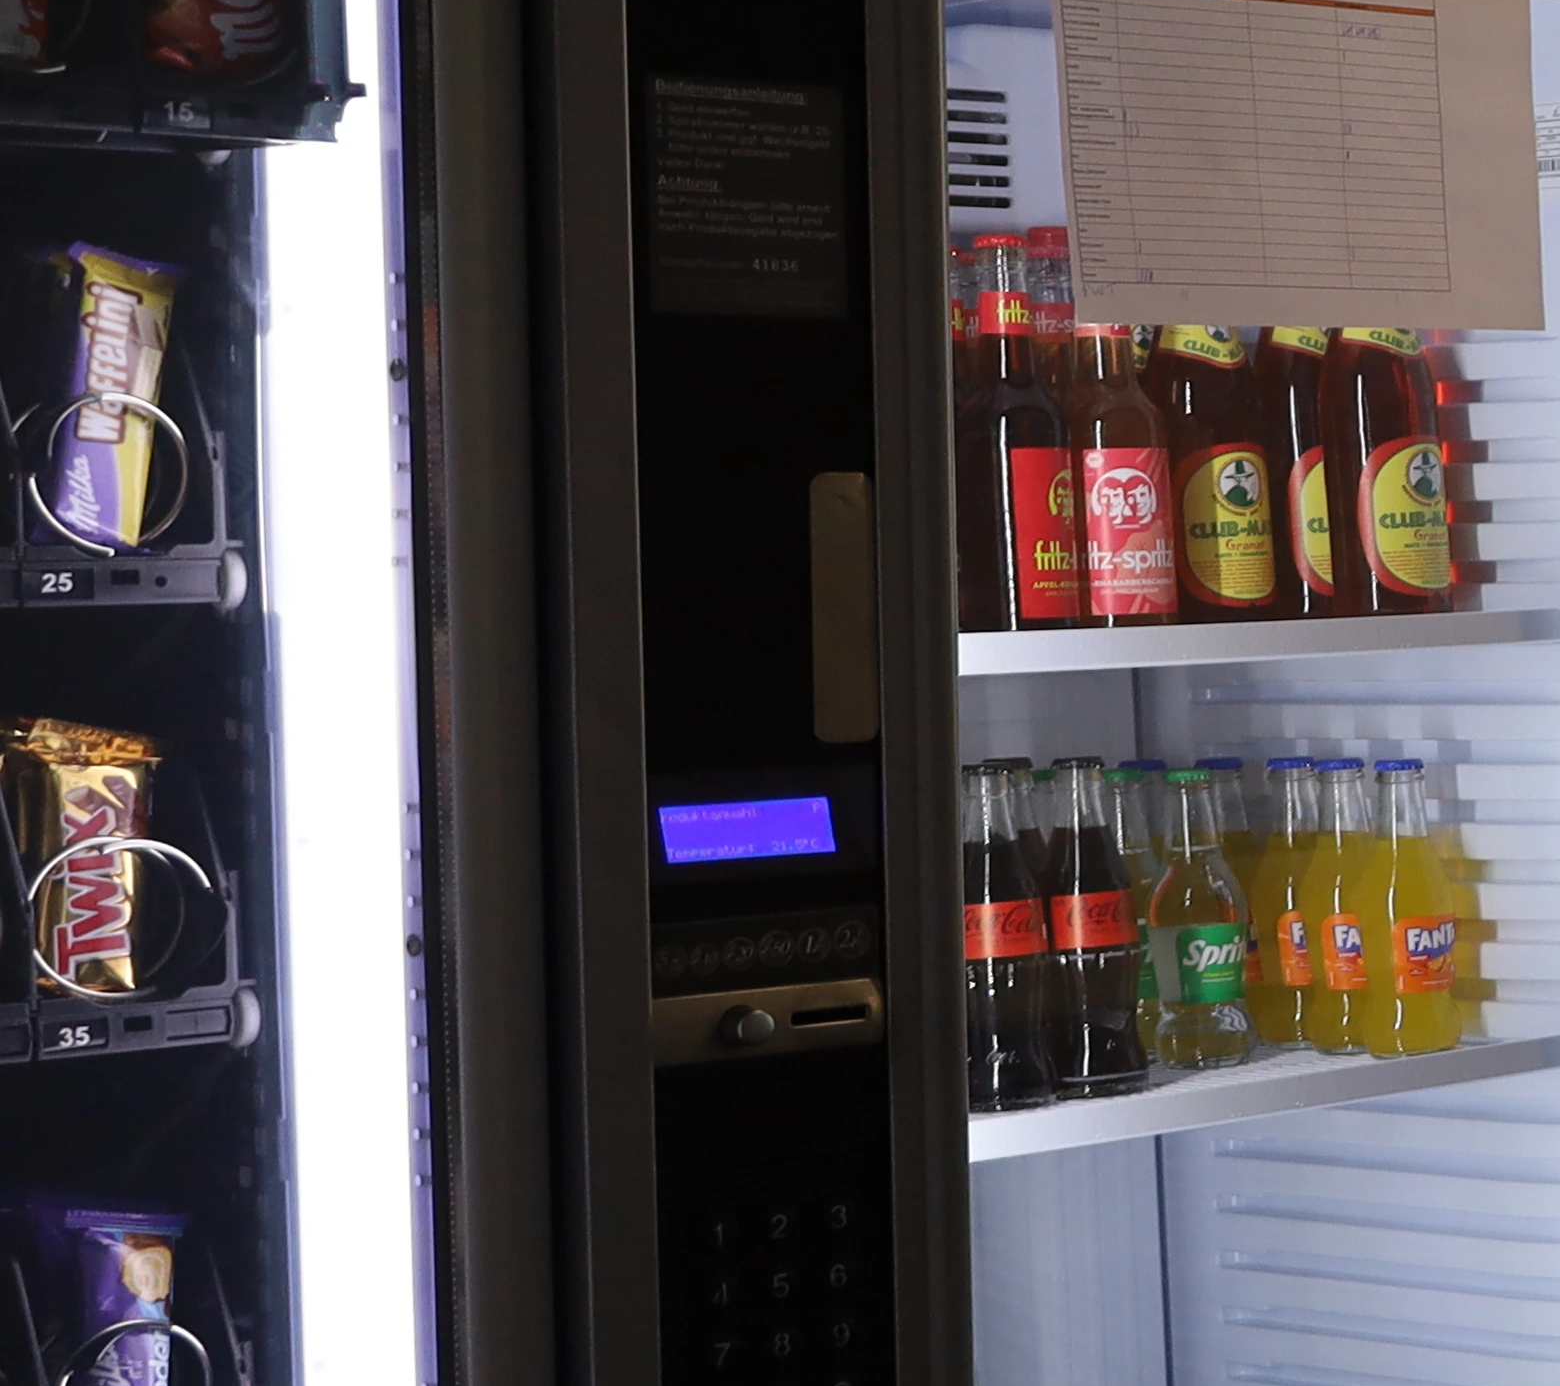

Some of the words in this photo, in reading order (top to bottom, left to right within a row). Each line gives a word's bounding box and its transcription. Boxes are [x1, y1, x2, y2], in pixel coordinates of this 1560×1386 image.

[162, 100, 195, 123] 15
[55, 453, 102, 533] Milka
[40, 571, 74, 594] 25
[58, 1026, 91, 1049] 35
[715, 1221, 724, 1249] 1
[771, 1213, 789, 1240] 2
[830, 1204, 849, 1230] 3
[712, 1281, 729, 1306] 4
[772, 1272, 791, 1299] 5
[829, 1263, 849, 1288] 6
[712, 1341, 732, 1369] 7
[773, 1332, 792, 1357] 8
[833, 1321, 851, 1347] 9
